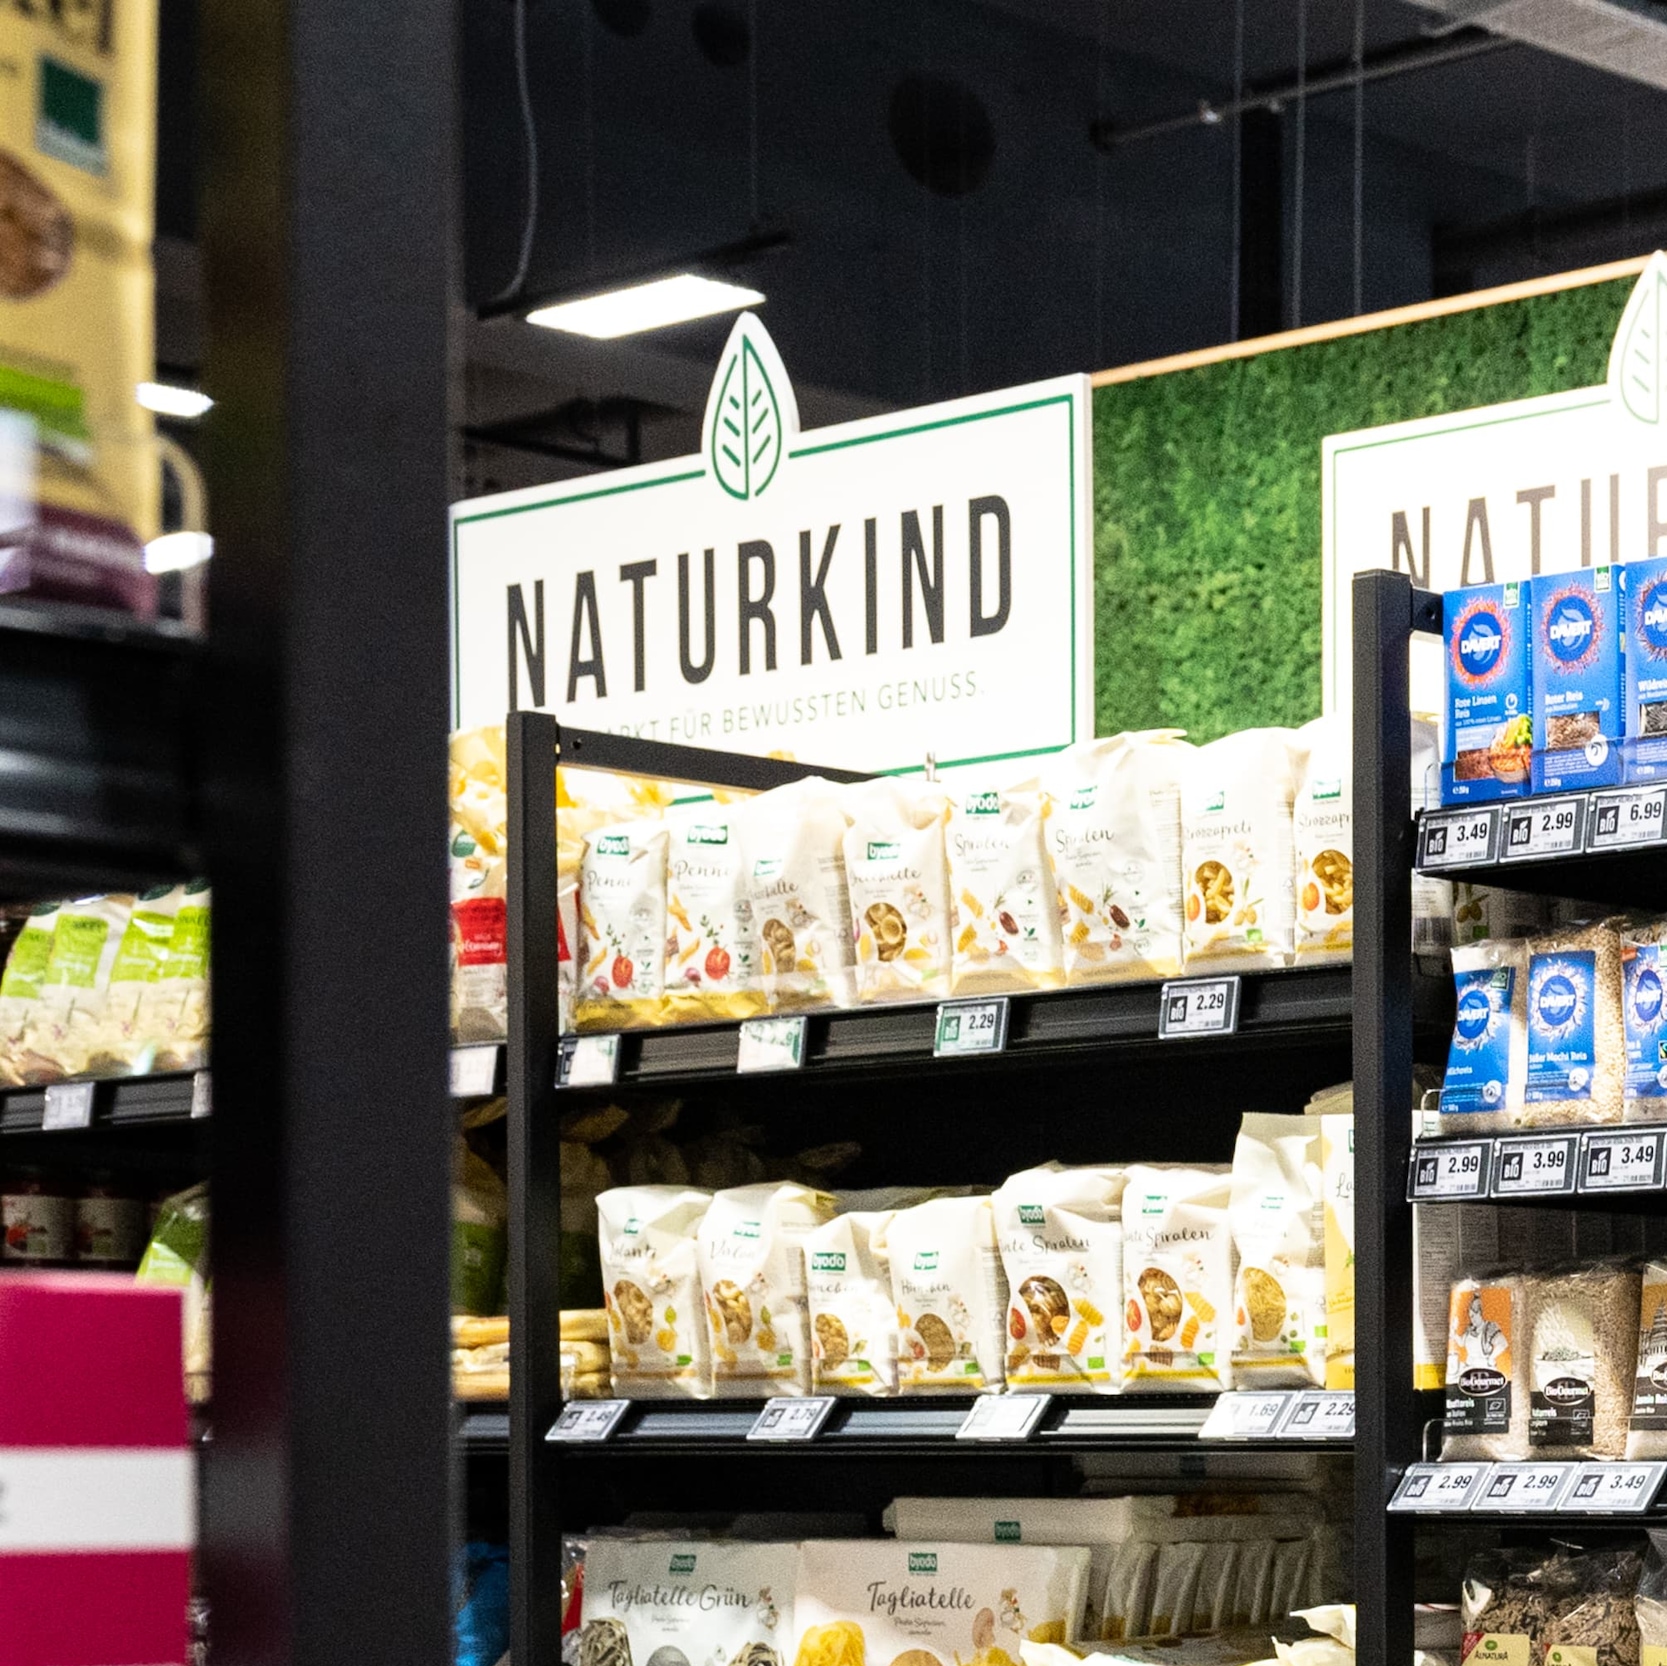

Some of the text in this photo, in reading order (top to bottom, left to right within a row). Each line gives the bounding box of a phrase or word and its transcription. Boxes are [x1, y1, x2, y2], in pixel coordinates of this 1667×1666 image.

[506, 494, 1013, 712] NATURKIND
[722, 690, 867, 735] BEWUSSTEN
[1456, 822, 1488, 843] 3.49
[1195, 993, 1225, 1012] 2.29
[1447, 1155, 1480, 1174] 2.99
[1437, 1474, 1473, 1492] 2.99
[1609, 1474, 1647, 1492] 3.49
[608, 1581, 752, 1613] Tagliatelle Grün
[866, 1581, 975, 1613] Tagliatelle
